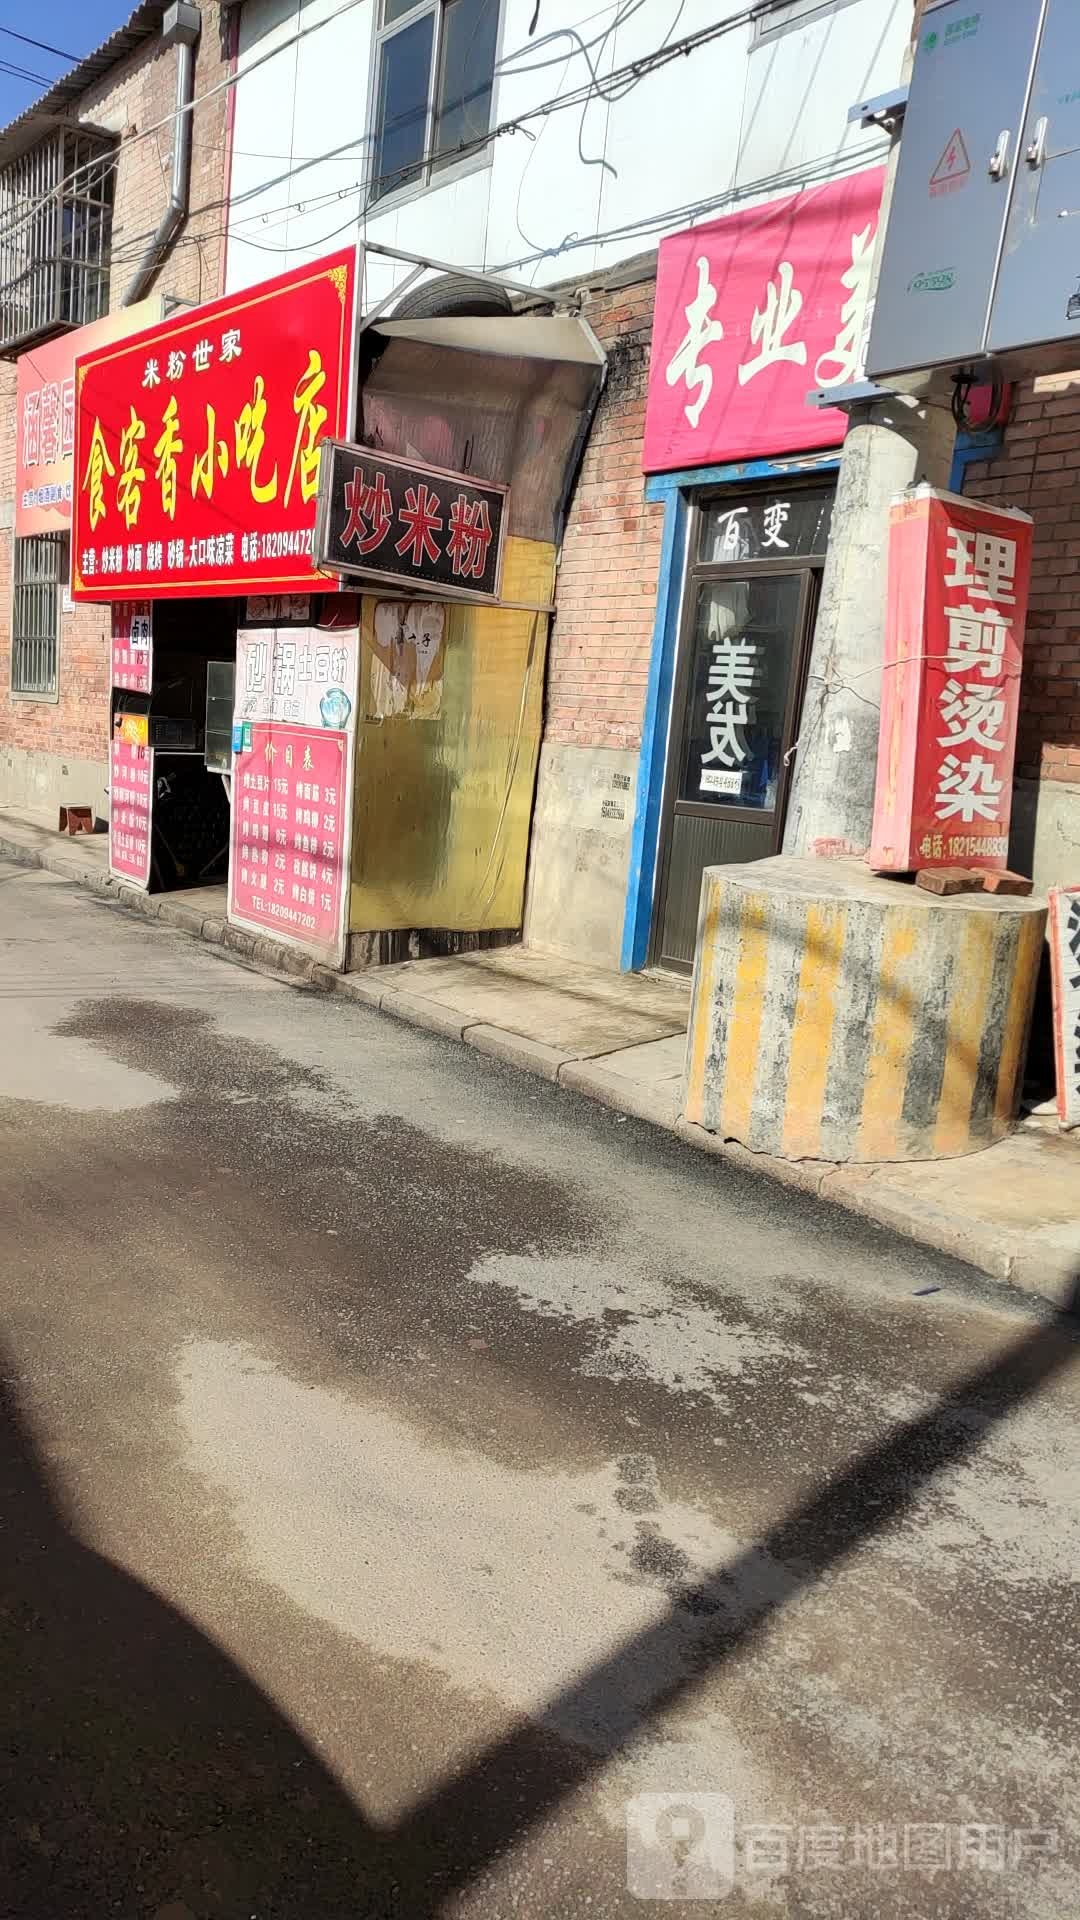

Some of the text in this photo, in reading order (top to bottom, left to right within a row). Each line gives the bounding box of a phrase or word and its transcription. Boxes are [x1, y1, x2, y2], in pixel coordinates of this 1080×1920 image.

[142, 328, 242, 388] 米粉世家
[82, 350, 327, 532] 食客香小吃店
[340, 467, 493, 579] 炒米粉
[716, 500, 790, 550] 百变
[102, 544, 122, 574] 炒米粉
[127, 543, 142, 572] 炒面
[146, 541, 162, 571] 烧烤
[167, 538, 184, 569] 砂锅
[189, 532, 234, 567] 大口味凉菜
[246, 642, 348, 695] 砂锅土豆粉
[933, 526, 1017, 824] 理剪烫染
[701, 637, 756, 766] 美发
[265, 741, 314, 771] 价目表
[273, 778, 288, 795] 15元
[325, 787, 336, 806] 3元
[273, 803, 288, 820] 15元
[323, 814, 335, 832] 2元
[275, 853, 286, 870] 2元
[322, 867, 333, 885] 4元
[323, 841, 335, 858] 2元
[273, 878, 285, 896] 2元
[321, 894, 332, 912] 1元
